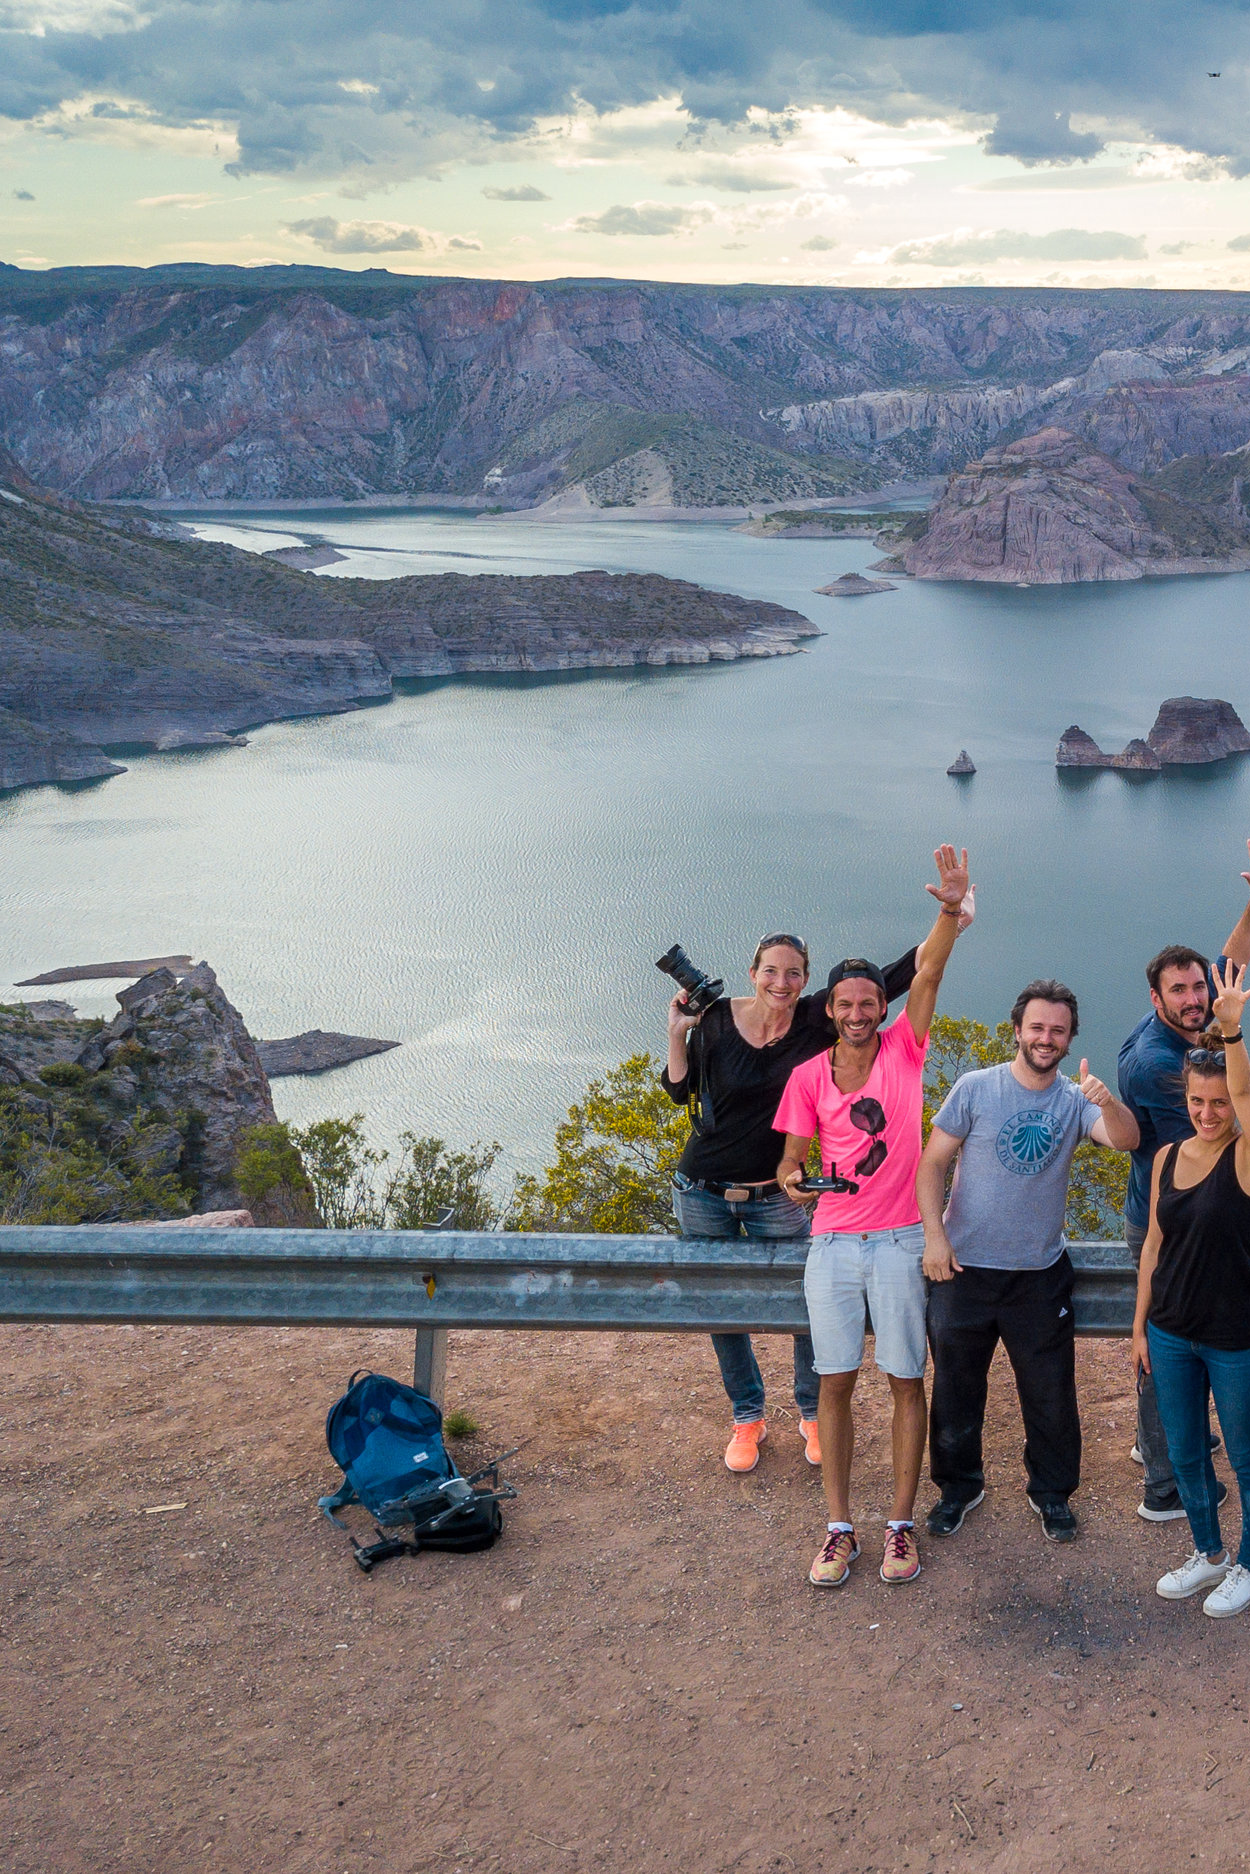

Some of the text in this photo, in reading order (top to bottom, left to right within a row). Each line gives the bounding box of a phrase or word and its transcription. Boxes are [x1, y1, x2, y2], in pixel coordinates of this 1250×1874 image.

[1002, 1113, 1061, 1135] EL CAMINO
[999, 1149, 1059, 1173] DE SANTIAGO
